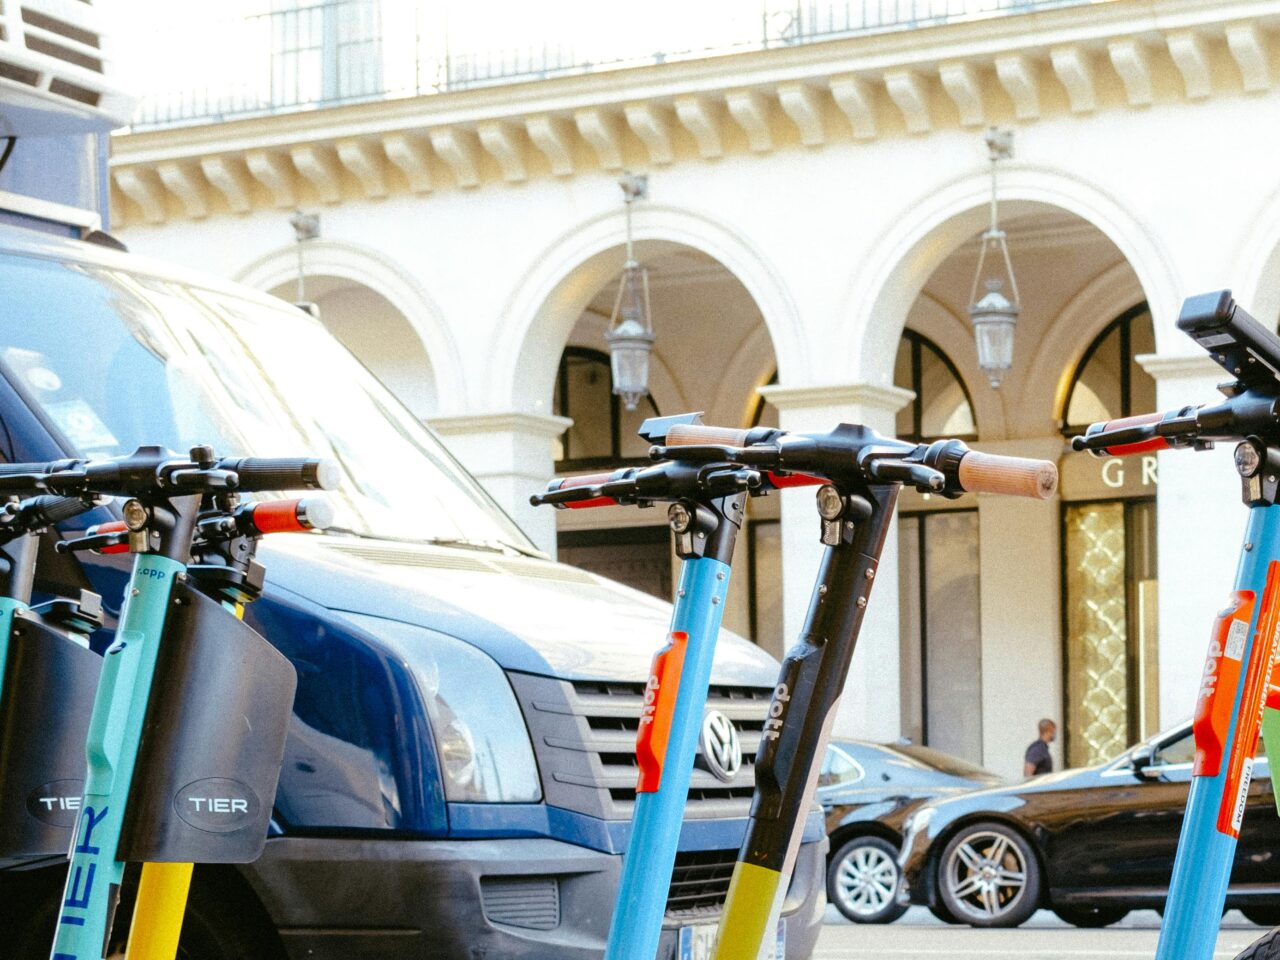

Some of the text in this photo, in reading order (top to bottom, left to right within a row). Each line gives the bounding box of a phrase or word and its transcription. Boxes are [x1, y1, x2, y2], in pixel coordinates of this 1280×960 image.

[1202, 640, 1222, 697] dott
[640, 675, 660, 725] dott
[762, 683, 790, 741] dott
[40, 797, 81, 811] TIE
[189, 797, 248, 814] TIER
[1236, 765, 1252, 823] FREEDOM
